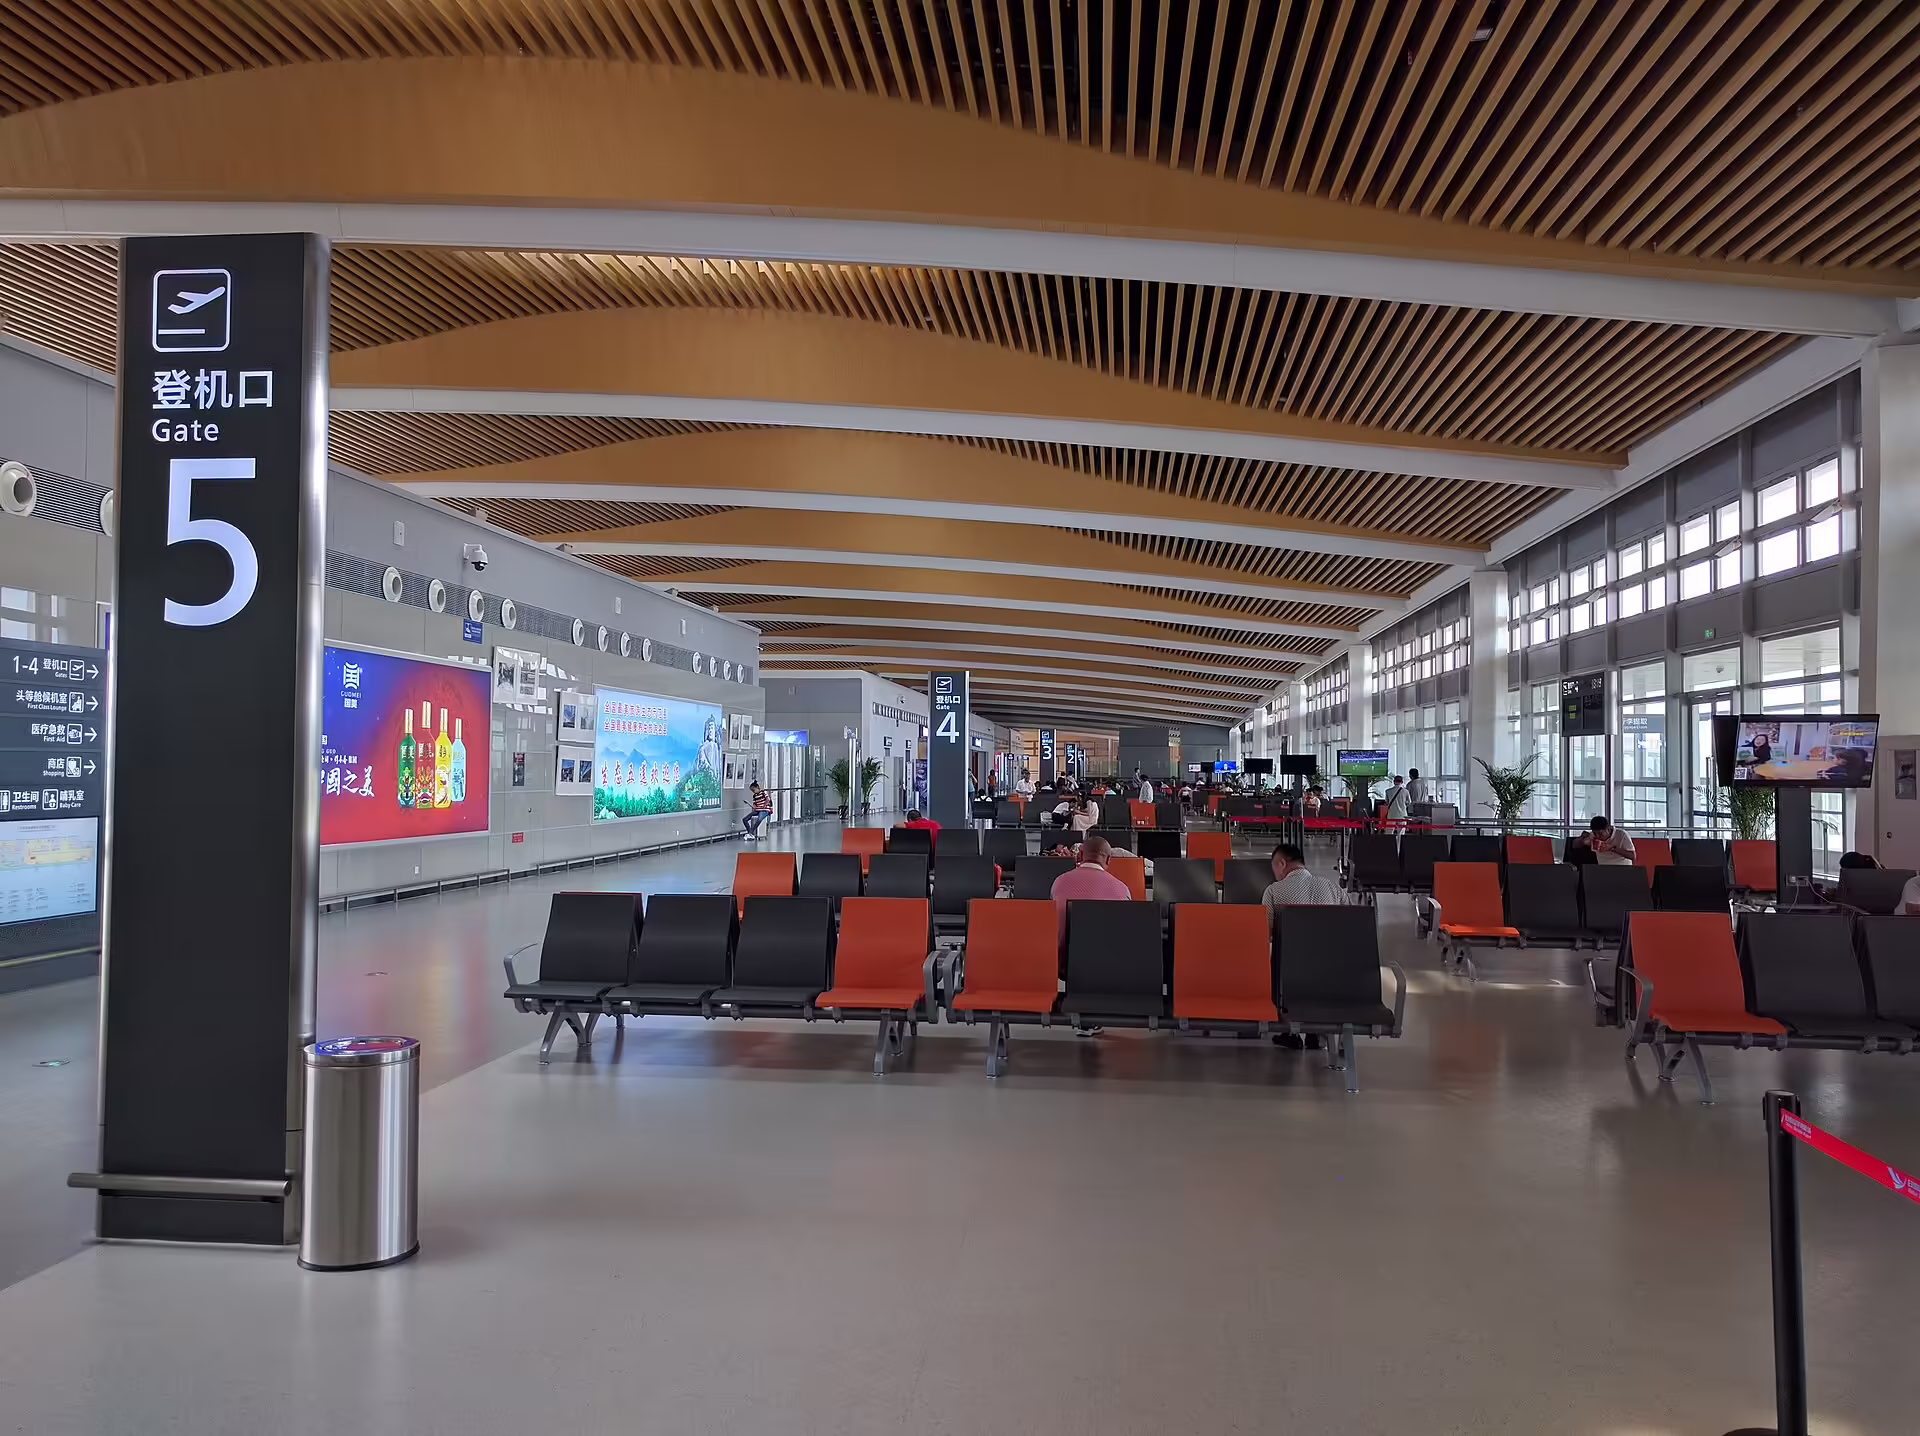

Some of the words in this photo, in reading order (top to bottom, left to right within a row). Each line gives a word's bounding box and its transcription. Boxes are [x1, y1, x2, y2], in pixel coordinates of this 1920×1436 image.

[152, 368, 275, 410] 登机口
[151, 418, 220, 443] Gate
[164, 457, 259, 627] 5
[13, 655, 39, 675] 1-4
[43, 658, 68, 671] 登机口
[16, 689, 68, 704] 头等舱候机室
[936, 695, 960, 704] 登机口
[50, 704, 67, 712] Lounge
[31, 723, 66, 735] 医疗急救
[936, 711, 960, 744] 4
[43, 735, 55, 743] First
[56, 735, 66, 743] Aid
[1042, 745, 1053, 761] 3
[1067, 753, 1075, 764] 2
[47, 758, 65, 770] 商店
[12, 791, 40, 803] 卫生间
[60, 790, 84, 802] 哺乳室
